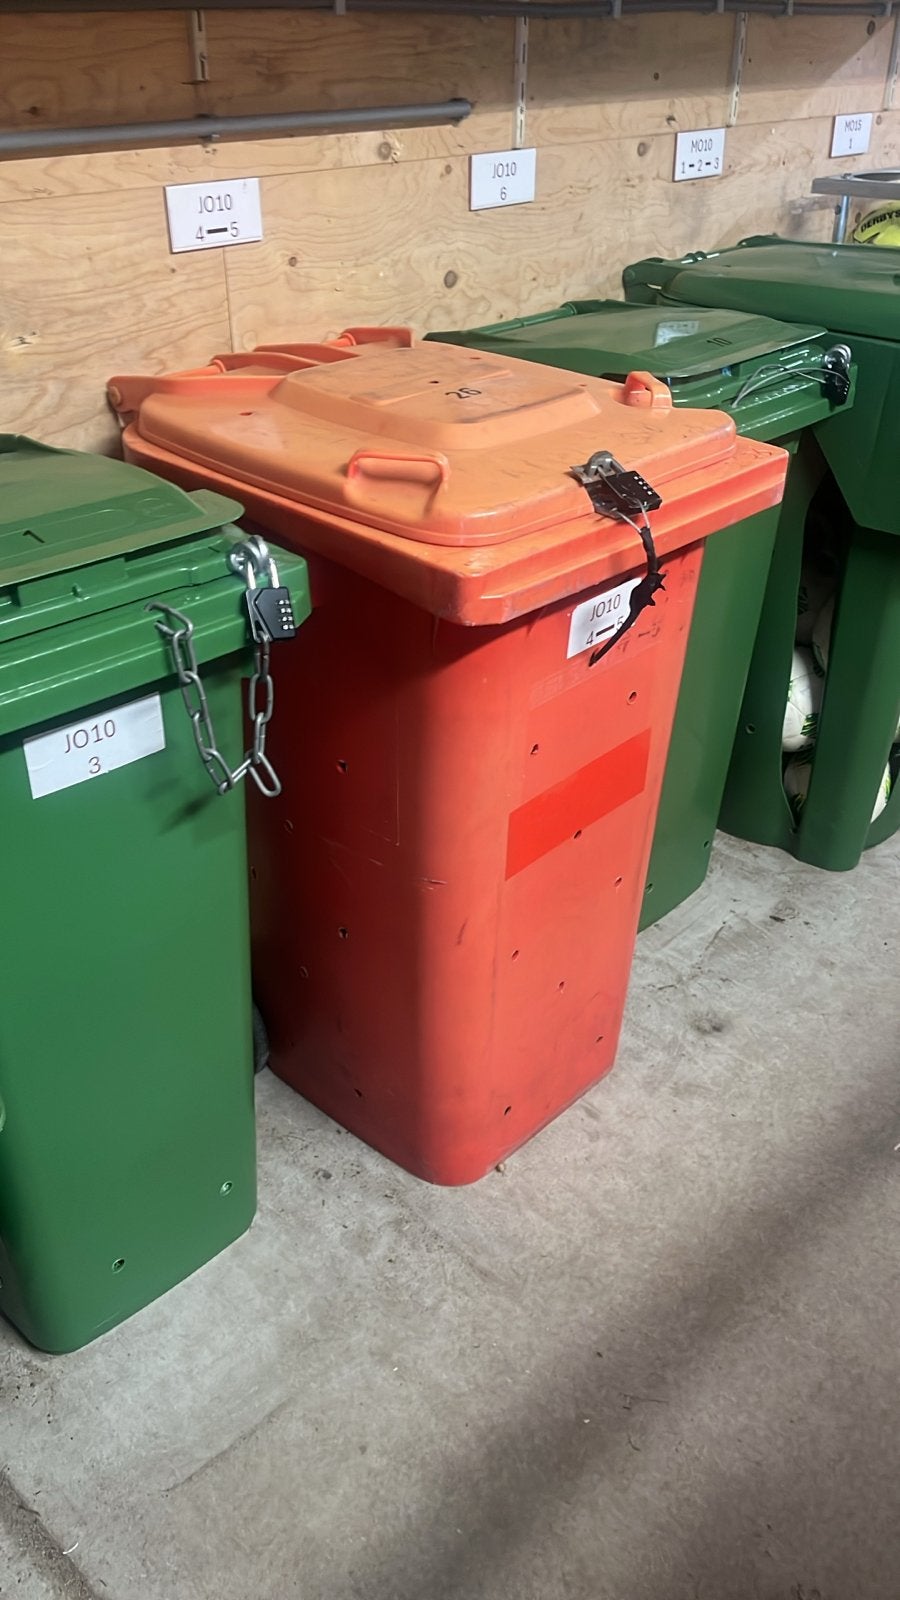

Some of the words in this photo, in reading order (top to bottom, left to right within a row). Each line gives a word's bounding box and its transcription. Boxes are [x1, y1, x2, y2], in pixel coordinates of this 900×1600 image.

[691, 138, 712, 153] MO10
[848, 138, 853, 149] 1
[492, 161, 517, 179] JO10
[500, 186, 507, 200] 6
[198, 194, 232, 214] JO10
[706, 338, 732, 347] 10
[445, 387, 482, 399] 26
[23, 530, 46, 543] 1
[590, 594, 621, 622] JO10
[65, 719, 116, 754] JO10
[88, 756, 101, 774] 3
